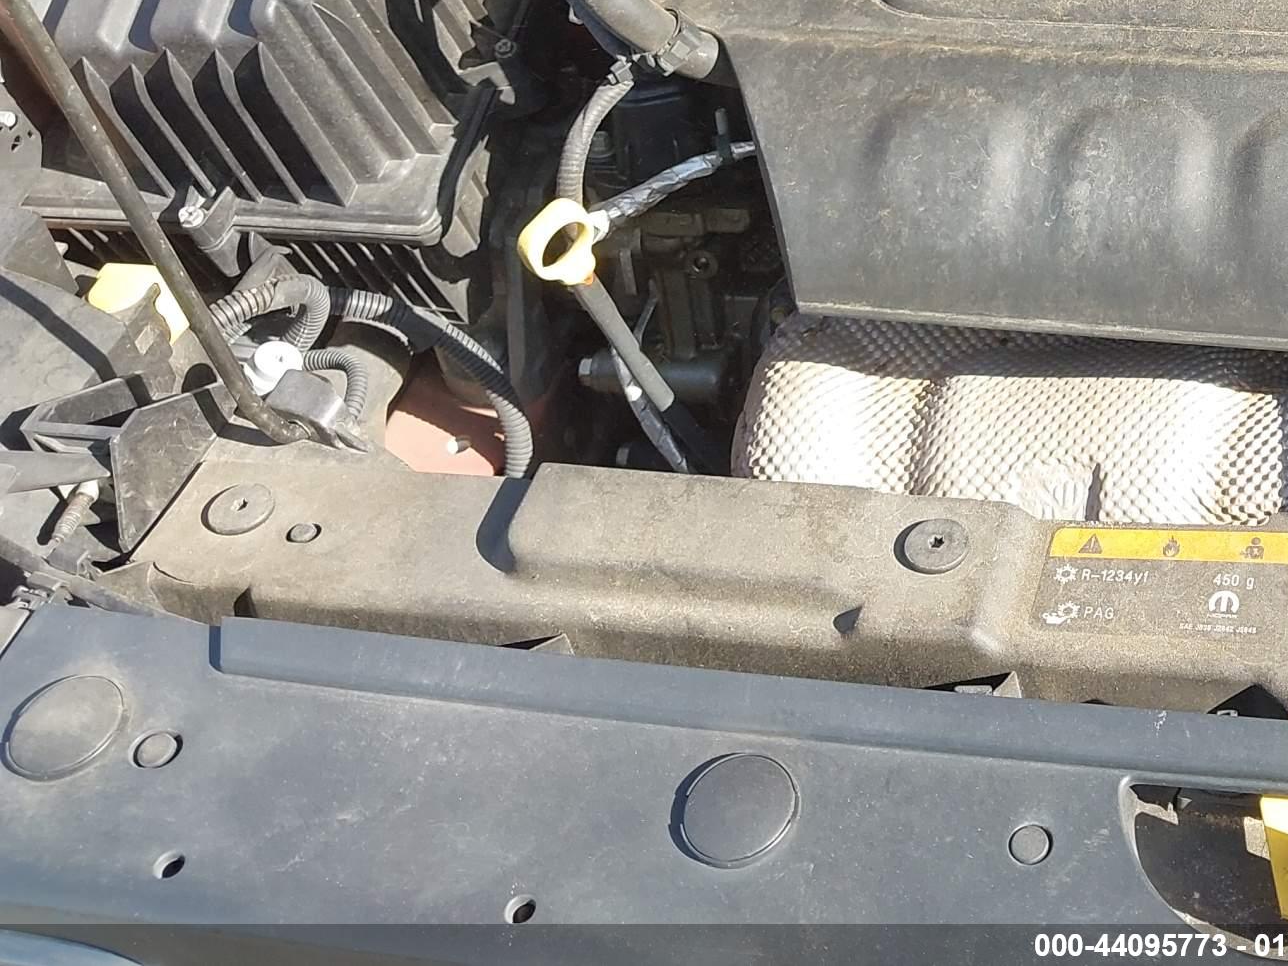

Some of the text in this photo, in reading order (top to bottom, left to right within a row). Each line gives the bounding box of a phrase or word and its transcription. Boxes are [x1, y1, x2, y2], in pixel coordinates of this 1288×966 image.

[1212, 572, 1256, 590] 450 g
[1083, 605, 1115, 620] PAG
